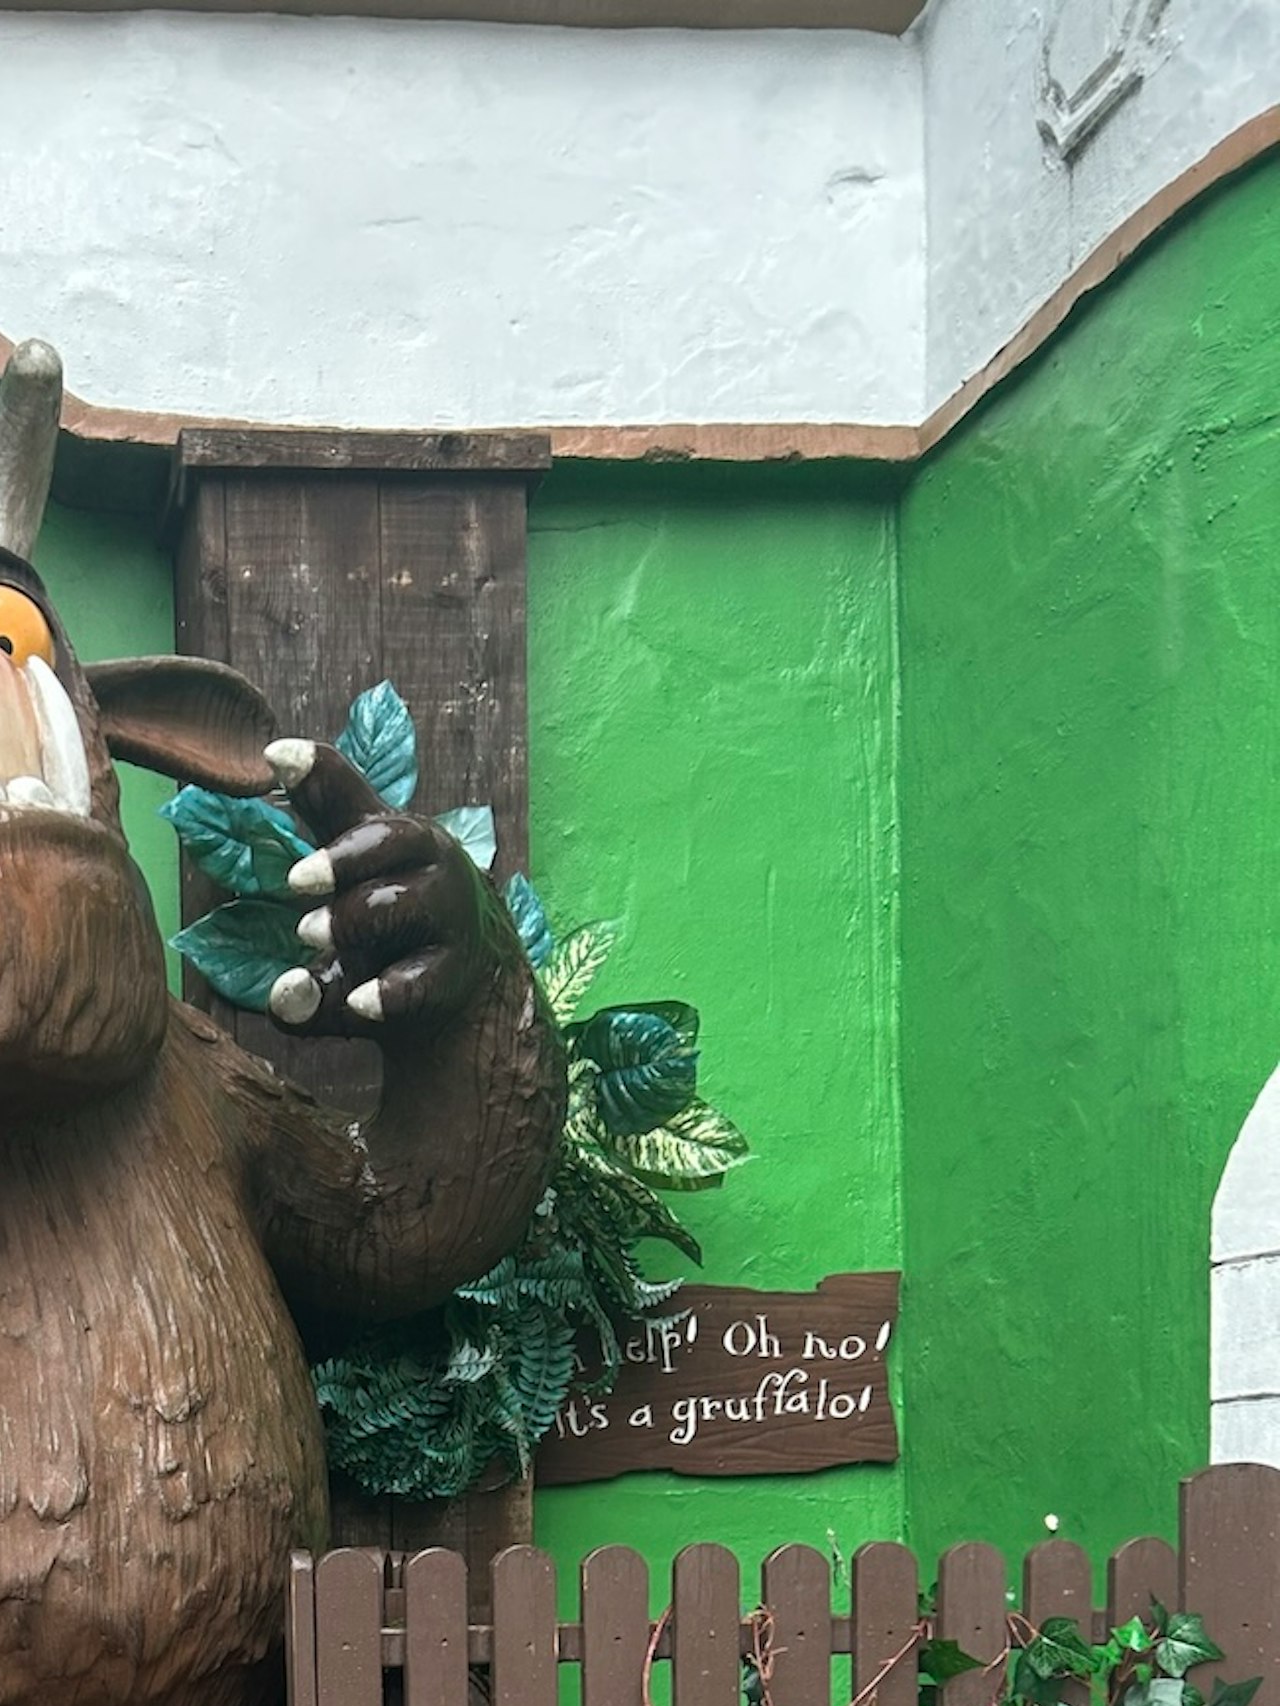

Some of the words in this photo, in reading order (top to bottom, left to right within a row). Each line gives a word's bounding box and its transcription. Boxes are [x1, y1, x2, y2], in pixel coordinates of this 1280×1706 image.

[722, 1313, 784, 1360] Oh
[801, 1320, 893, 1362] no!
[627, 1403, 656, 1429] a
[668, 1368, 873, 1447] gruffalo!
